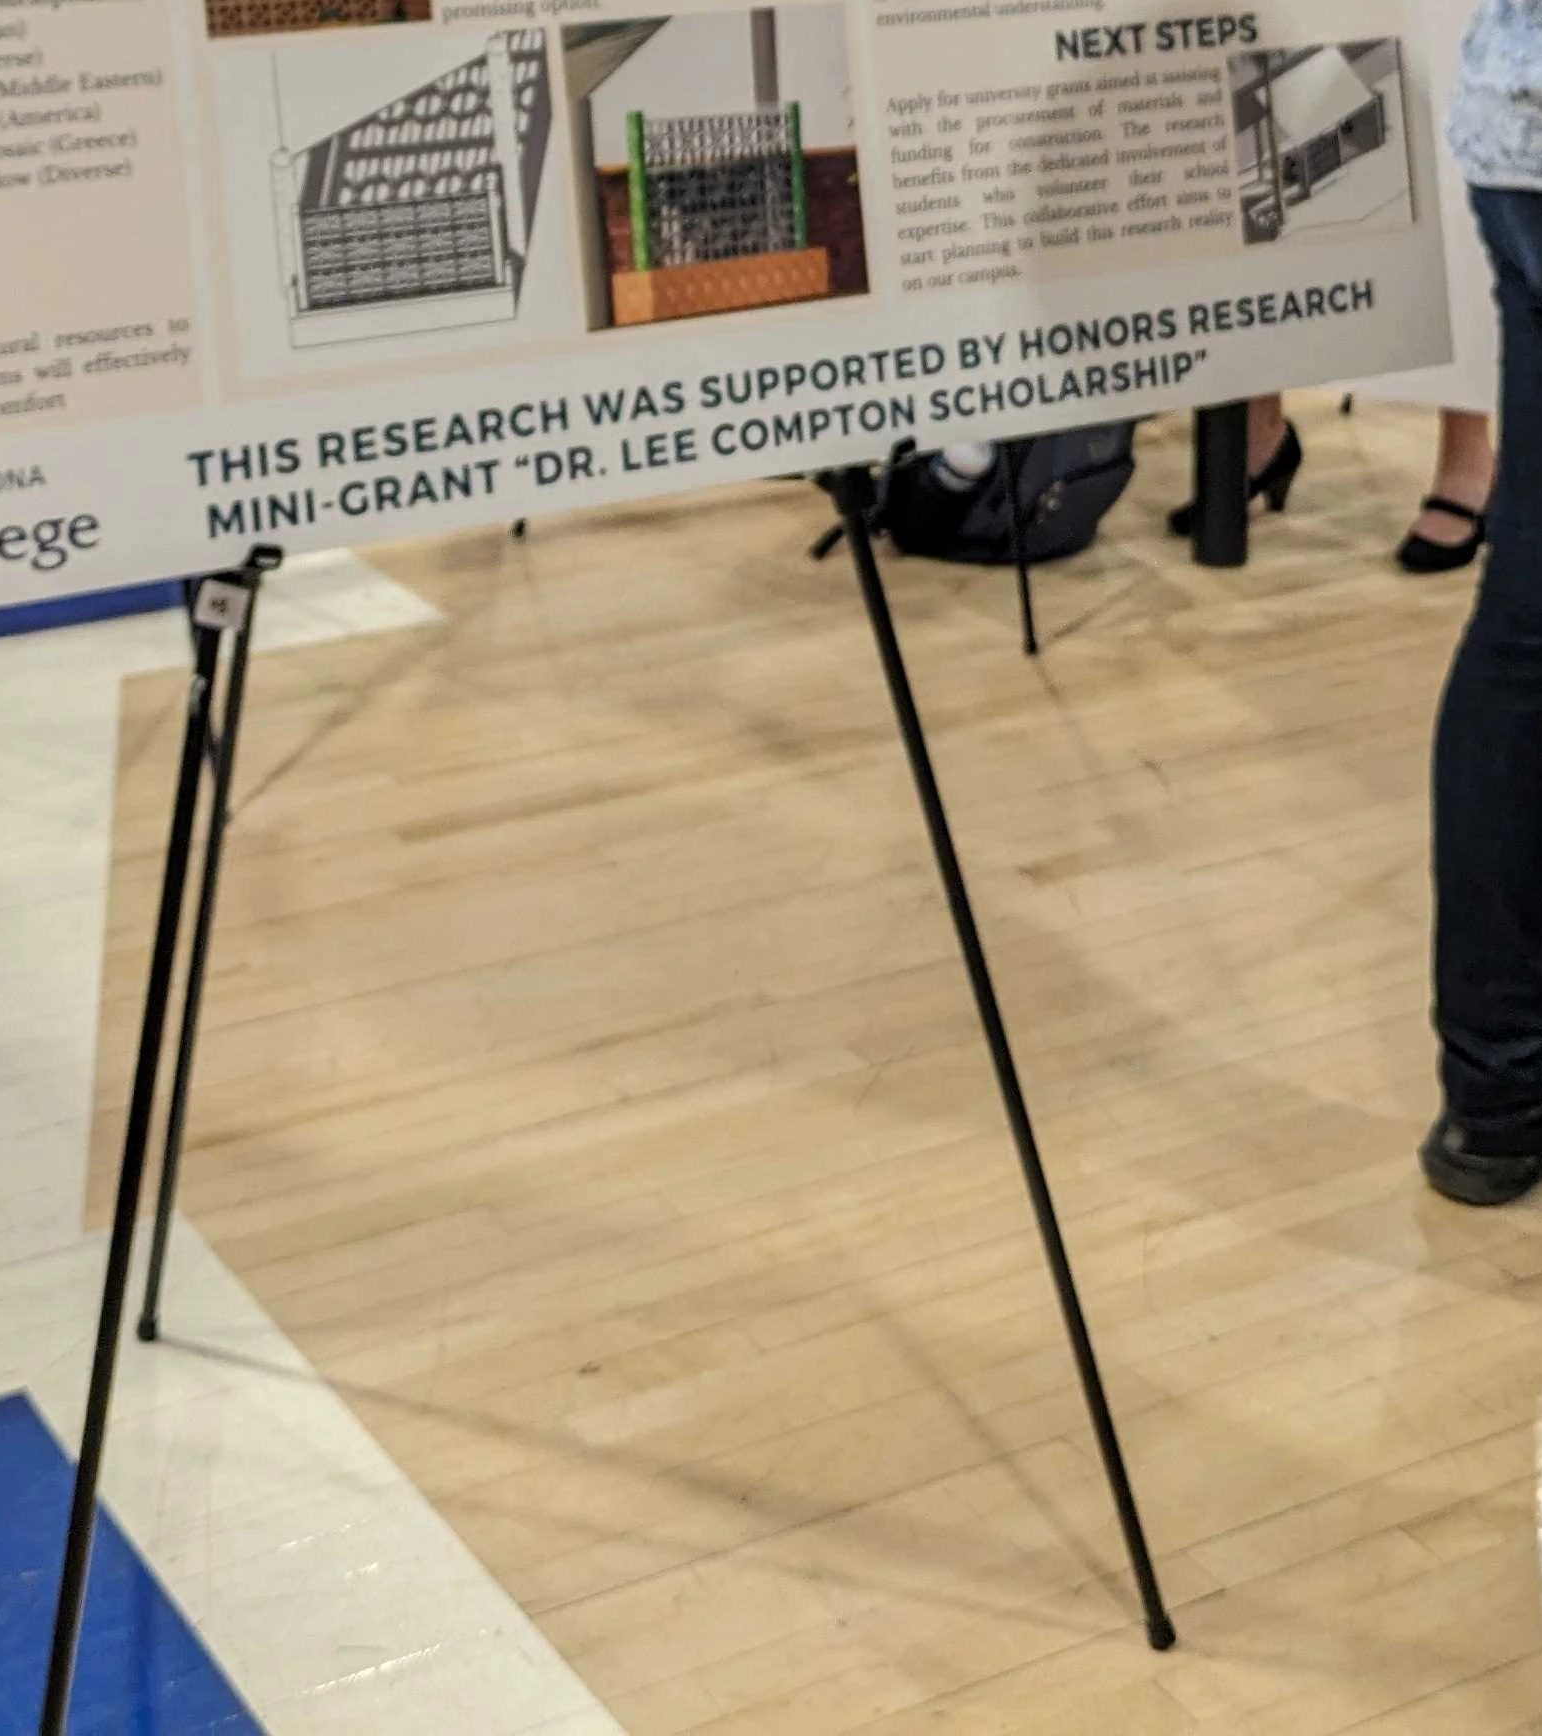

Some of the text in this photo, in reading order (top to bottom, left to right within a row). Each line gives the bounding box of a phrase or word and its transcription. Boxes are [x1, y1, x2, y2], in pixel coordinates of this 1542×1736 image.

[1055, 13, 1259, 62] NEXT STEPS
[187, 279, 1373, 488] THIS RESEARCH WAS SUPPORTED BY HONORS RESEARCH
[621, 427, 697, 472] LEE
[711, 394, 915, 457] COMPTON
